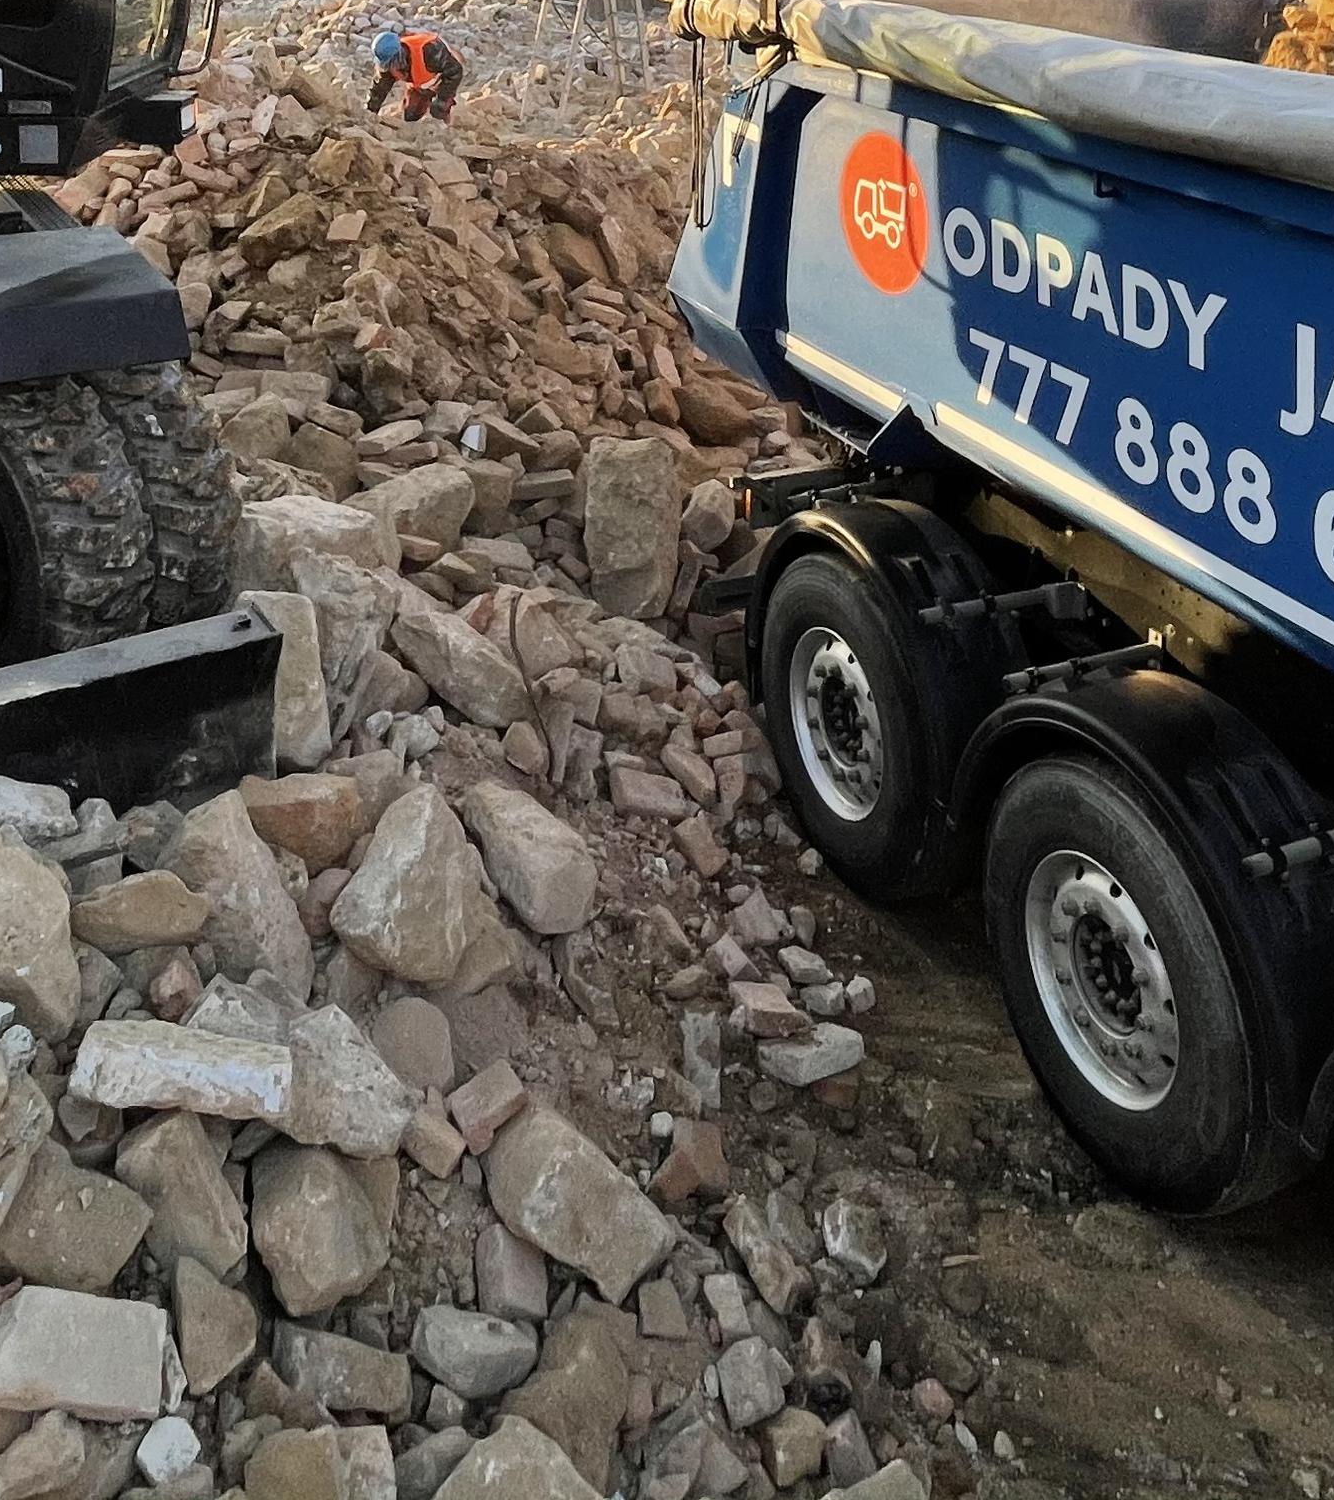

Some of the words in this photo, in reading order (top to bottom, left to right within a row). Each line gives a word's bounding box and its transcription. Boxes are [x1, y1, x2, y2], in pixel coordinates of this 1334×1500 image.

[943, 207, 1227, 370] ODPADY
[966, 328, 1091, 445] 777
[1114, 396, 1277, 545] 888
